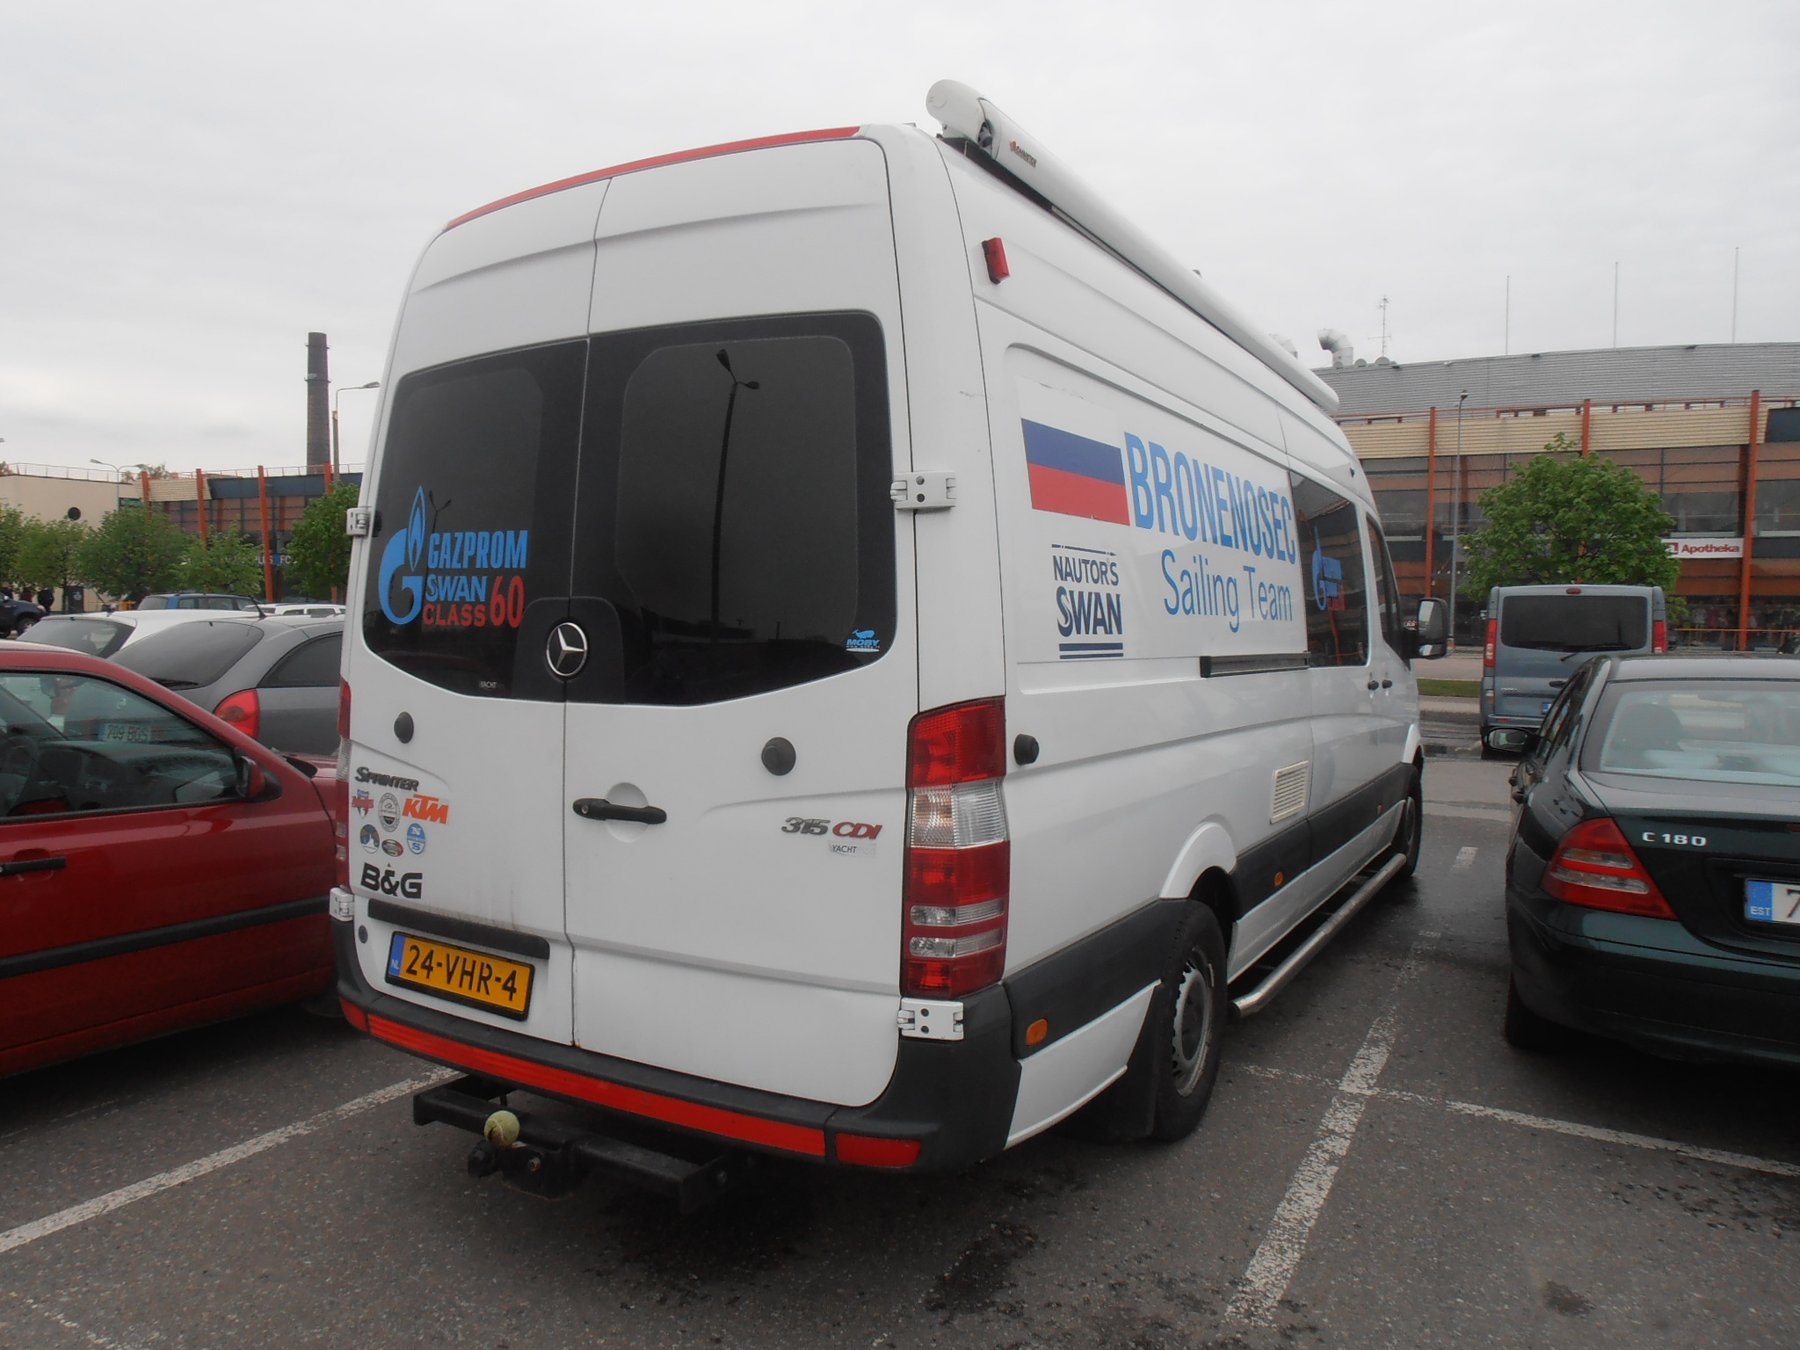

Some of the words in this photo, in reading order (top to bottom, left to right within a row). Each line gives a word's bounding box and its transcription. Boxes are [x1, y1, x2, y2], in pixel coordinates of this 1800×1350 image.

[1124, 431, 1297, 565] BRONENOSEC
[427, 530, 529, 569] GAZPROM
[1681, 544, 1740, 555] Apotheka
[425, 573, 488, 602] SWAN
[489, 575, 525, 628] 60
[1161, 549, 1241, 634] Sailing
[1242, 565, 1293, 622] Team
[422, 602, 487, 627] CLASS
[1056, 585, 1123, 637] SWAN
[402, 794, 449, 824] KTM
[781, 817, 831, 836] 315
[832, 822, 883, 840] CDI
[1642, 832, 1656, 842] C
[1662, 833, 1707, 847] 180
[832, 844, 857, 853] YACHT
[360, 862, 423, 899] B&G
[1751, 906, 1771, 916] EST
[391, 959, 400, 970] NL
[406, 945, 517, 1002] 24-VHR-4
